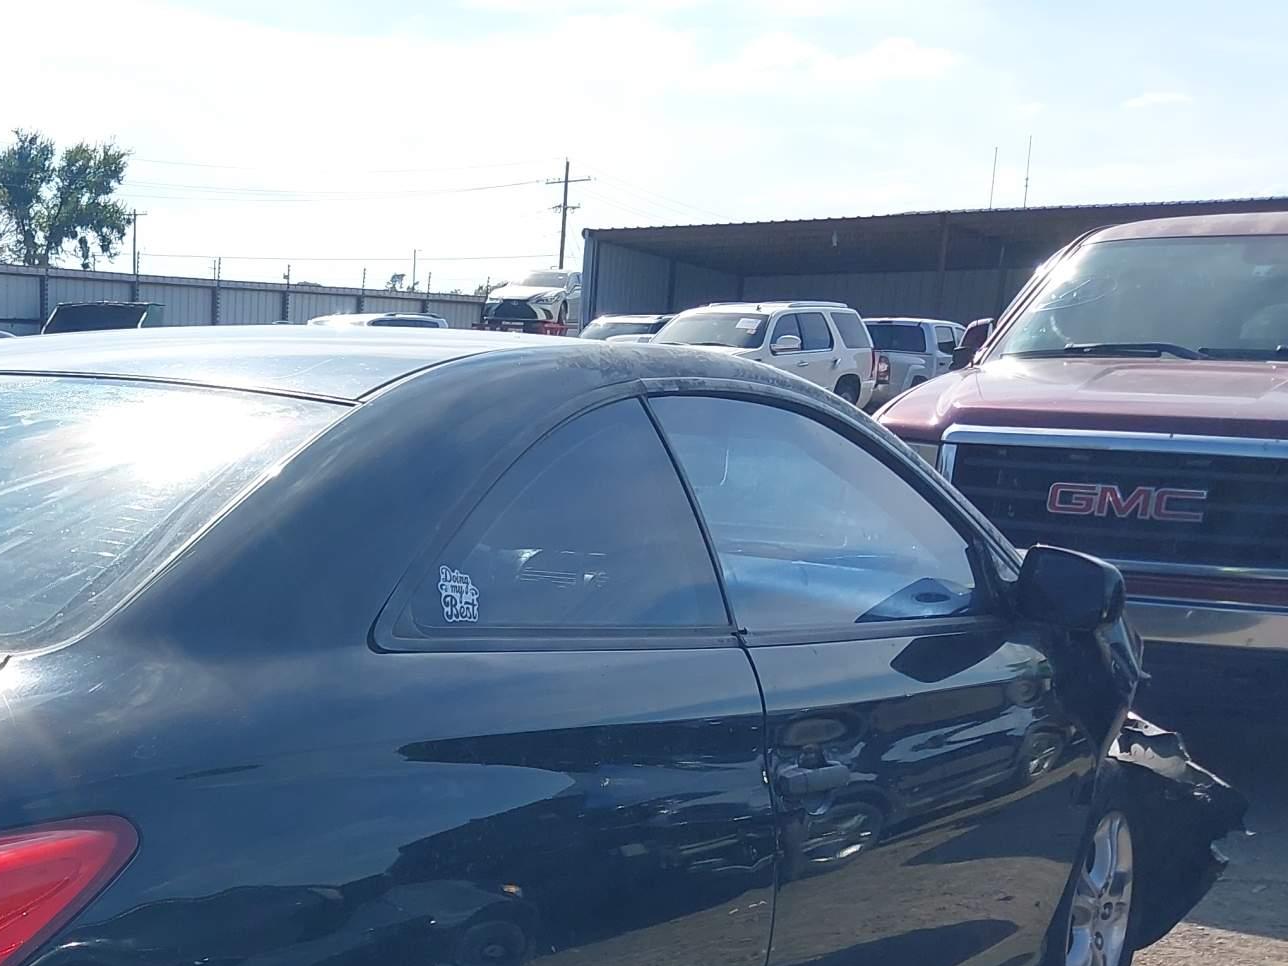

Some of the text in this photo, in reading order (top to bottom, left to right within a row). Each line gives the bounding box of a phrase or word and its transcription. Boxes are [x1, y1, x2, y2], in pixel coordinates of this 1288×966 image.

[1047, 482, 1208, 522] GMC
[441, 567, 470, 595] Doing
[443, 594, 477, 620] Best
